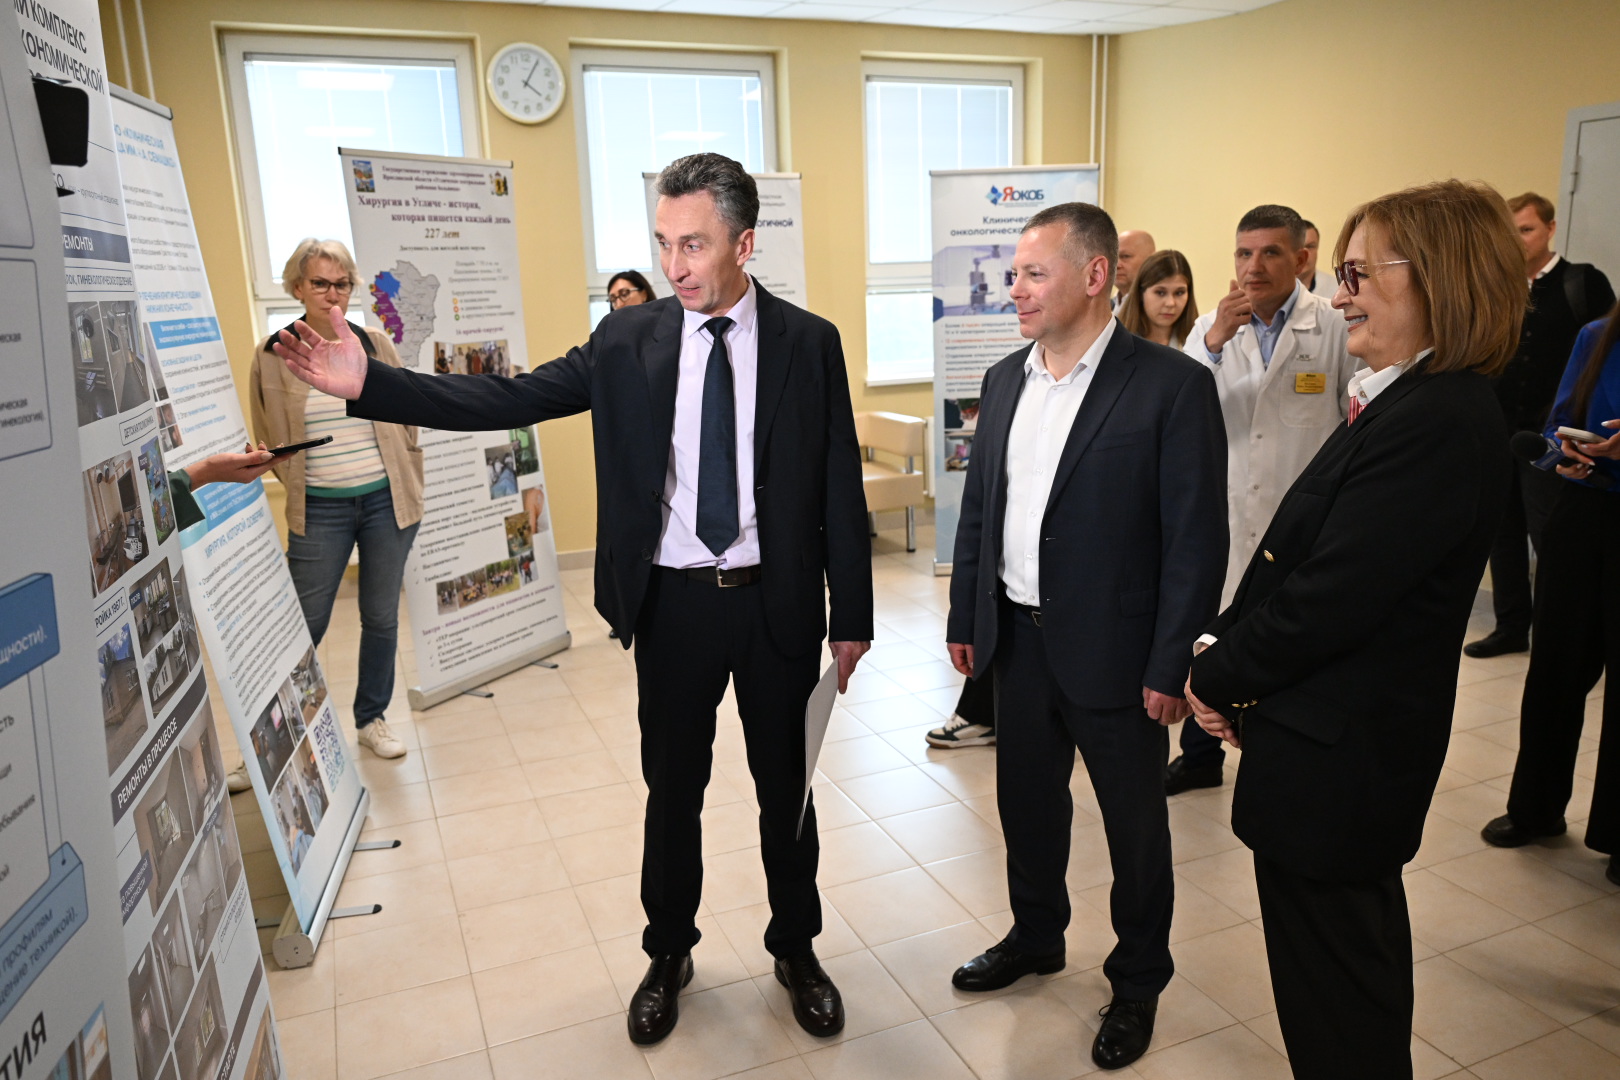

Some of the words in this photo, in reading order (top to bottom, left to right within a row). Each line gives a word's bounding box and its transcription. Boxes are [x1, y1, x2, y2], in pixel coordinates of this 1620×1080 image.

[31, 0, 87, 54] КОМПЛЕКС
[21, 29, 104, 94] КОНОМИЧЕСКОЙ
[1002, 186, 1044, 201] ЯОКОБ
[358, 196, 402, 208] Хирургия
[412, 198, 442, 208] Угличе
[448, 201, 481, 210] история,
[392, 214, 426, 224] которая
[428, 214, 462, 222] пишется
[465, 214, 493, 224] каждый
[494, 216, 511, 224] день
[755, 218, 794, 228] огичной
[983, 216, 1030, 225] Клиничес
[424, 228, 440, 238] 227
[442, 230, 460, 238] лет
[62, 235, 94, 252] ЕМОНТЫ
[95, 608, 112, 628] РОЙКА
[0, 716, 14, 732] сть
[117, 759, 148, 808] РЕМОНТЫ
[147, 754, 152, 768] В
[151, 717, 177, 760] ПРОЦЕССЕ
[0, 963, 28, 1002] ение
[0, 1011, 47, 1080] ТИЯ
